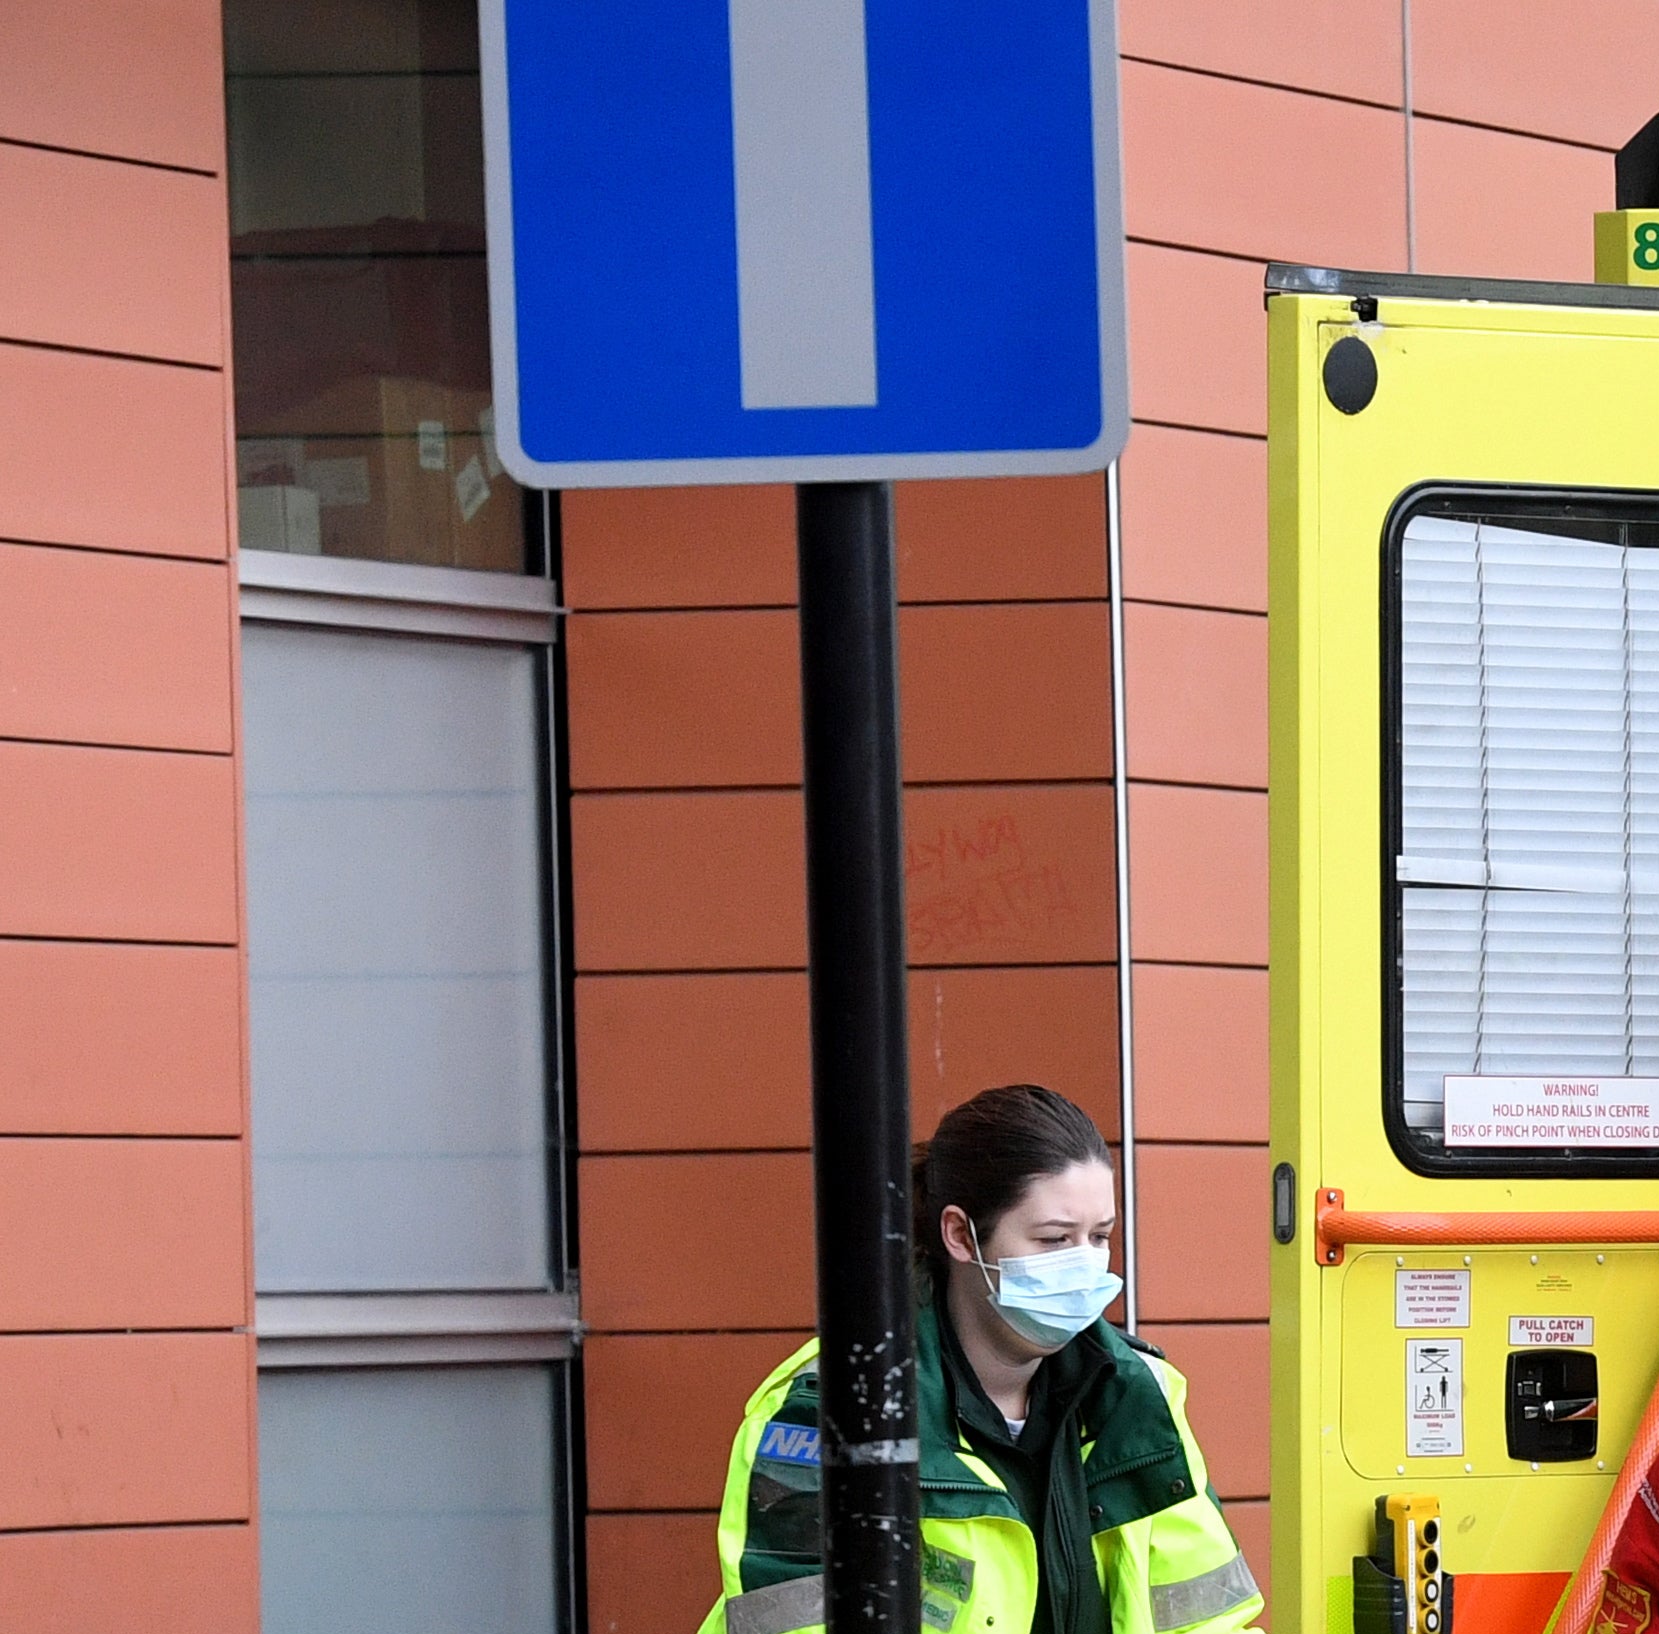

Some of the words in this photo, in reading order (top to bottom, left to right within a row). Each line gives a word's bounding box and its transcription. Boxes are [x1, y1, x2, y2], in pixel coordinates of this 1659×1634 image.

[1543, 1083, 1599, 1097] WARNING!
[1493, 1103, 1524, 1117] HOLD
[1527, 1103, 1559, 1117] HAND
[1562, 1104, 1592, 1118] RAILS
[1595, 1104, 1606, 1117] IN
[1609, 1104, 1650, 1118] CENTRE
[1451, 1124, 1475, 1137] RISK
[1478, 1125, 1494, 1137] OF
[1496, 1125, 1529, 1138] PINCH
[1532, 1125, 1564, 1138] POINT
[1567, 1125, 1600, 1138] WHEN
[1604, 1125, 1650, 1139] CLOSING
[1519, 1320, 1545, 1330] PULL
[1548, 1320, 1584, 1330] CATCH
[1528, 1332, 1542, 1342] TO
[1545, 1332, 1575, 1343] OPEN
[762, 1427, 822, 1460] NH
